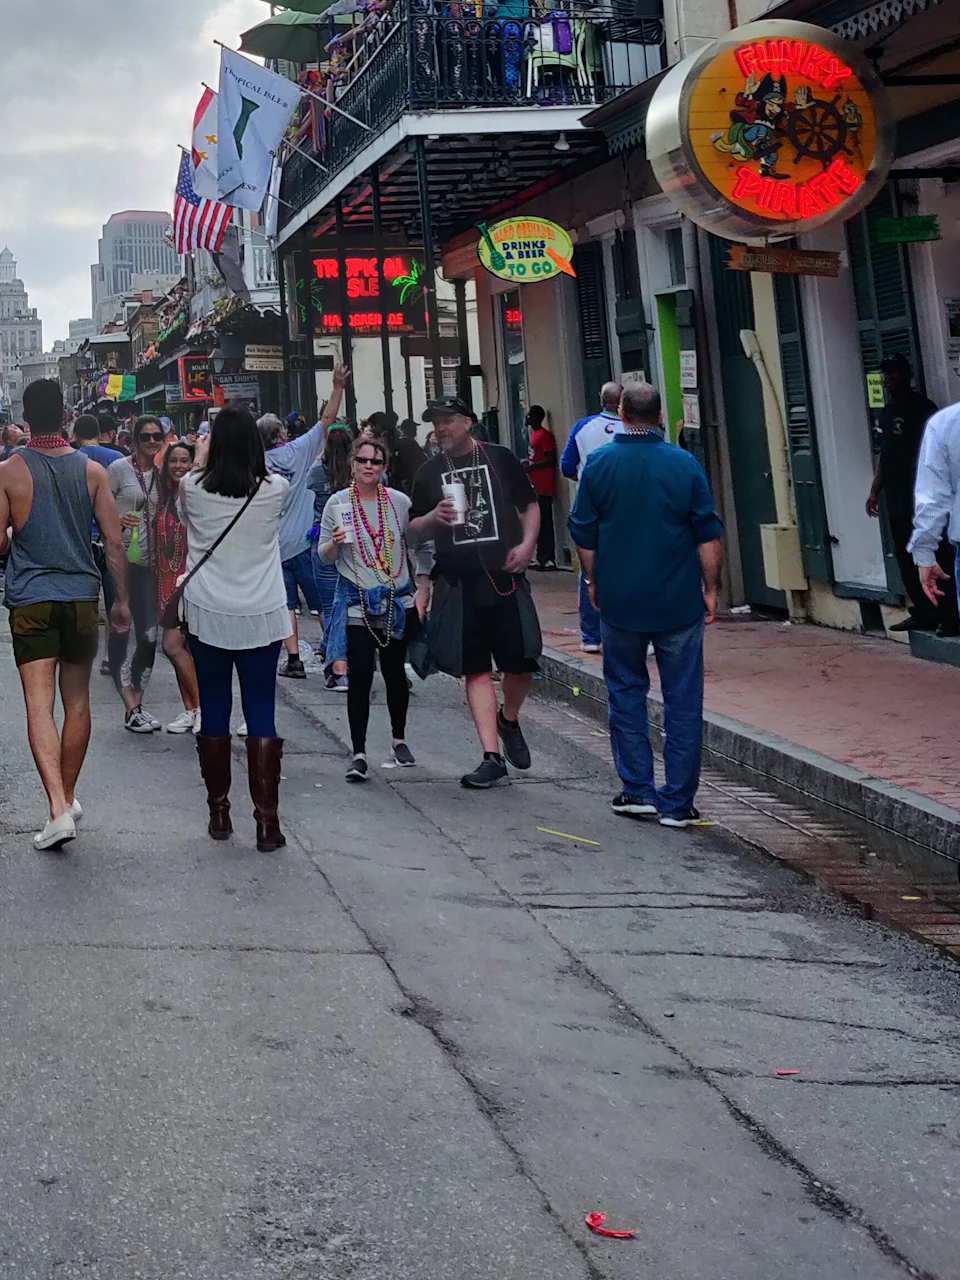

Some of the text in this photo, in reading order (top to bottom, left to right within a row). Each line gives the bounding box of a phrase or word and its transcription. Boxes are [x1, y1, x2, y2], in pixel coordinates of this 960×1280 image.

[734, 39, 853, 88] FUNKY
[732, 156, 860, 219] PIRATE
[493, 224, 515, 243] HAND
[502, 240, 546, 251] DRINKS
[505, 250, 546, 260] & BEER
[508, 260, 553, 276] TO GO
[347, 277, 380, 298] SLE
